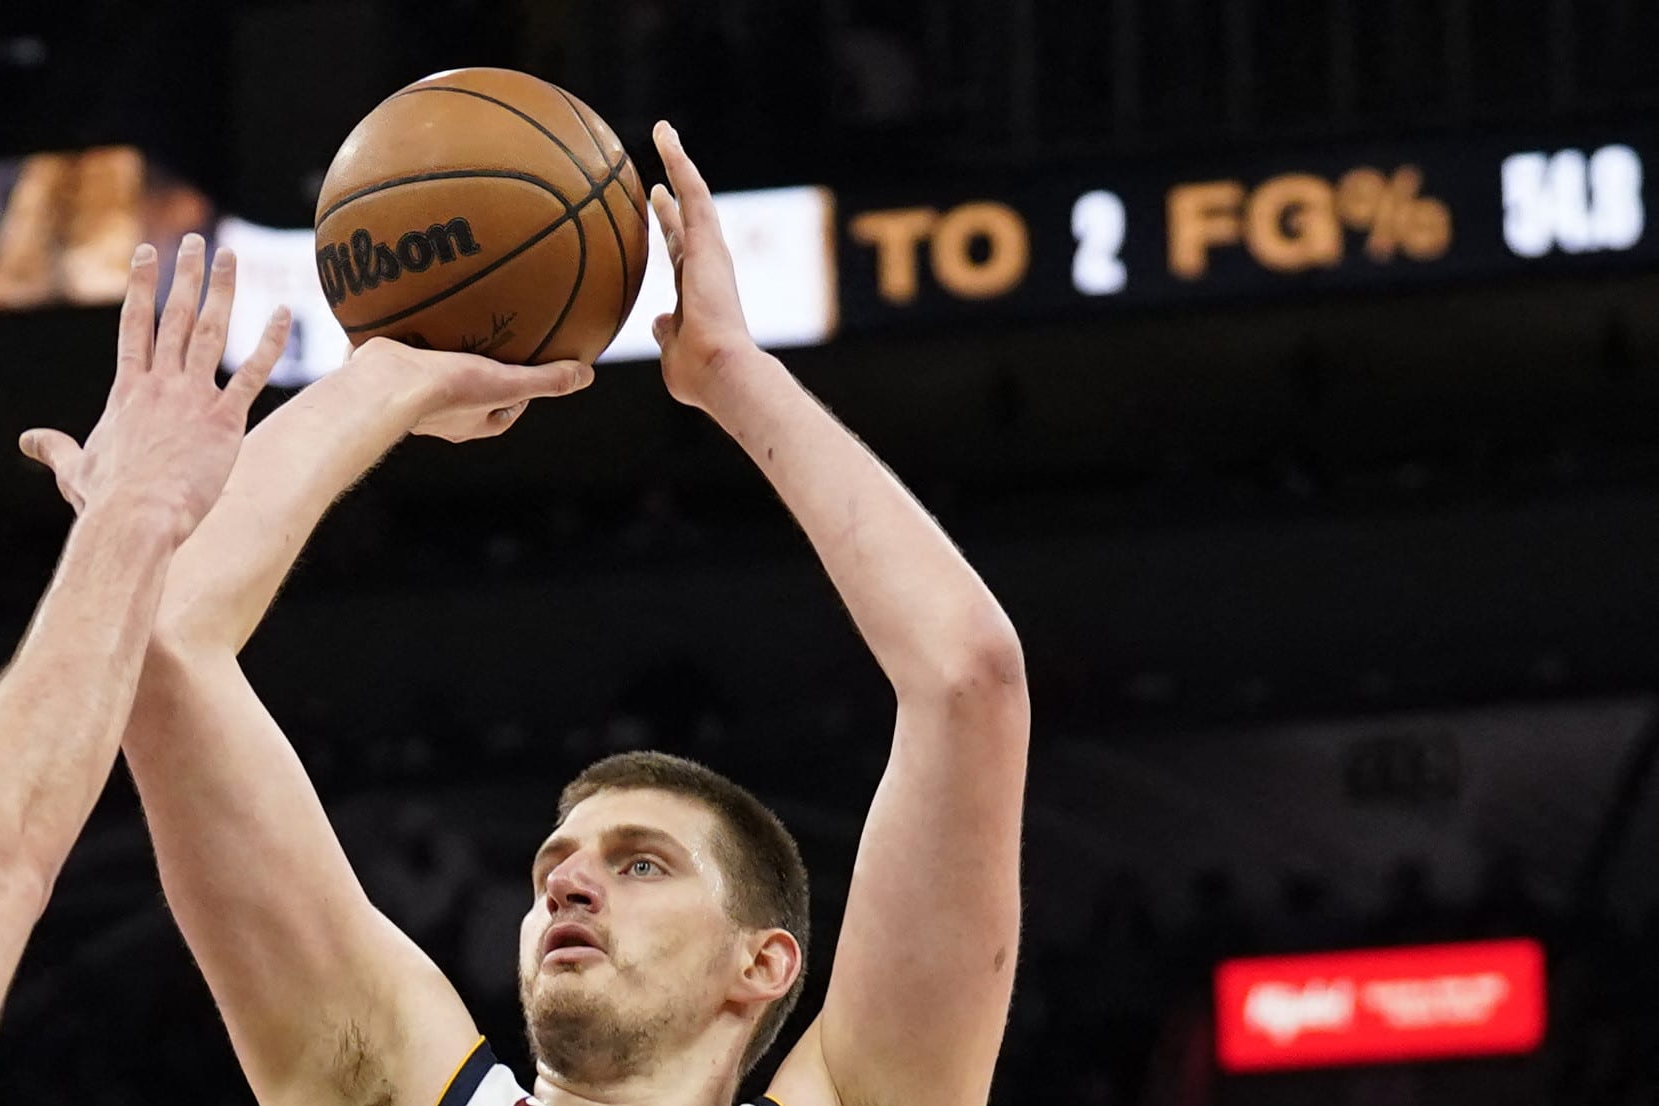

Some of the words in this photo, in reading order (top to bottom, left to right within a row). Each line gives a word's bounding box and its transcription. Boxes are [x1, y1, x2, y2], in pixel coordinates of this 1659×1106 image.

[848, 202, 1032, 304] TO
[1071, 188, 1128, 297] 2
[1166, 165, 1450, 284] FG%
